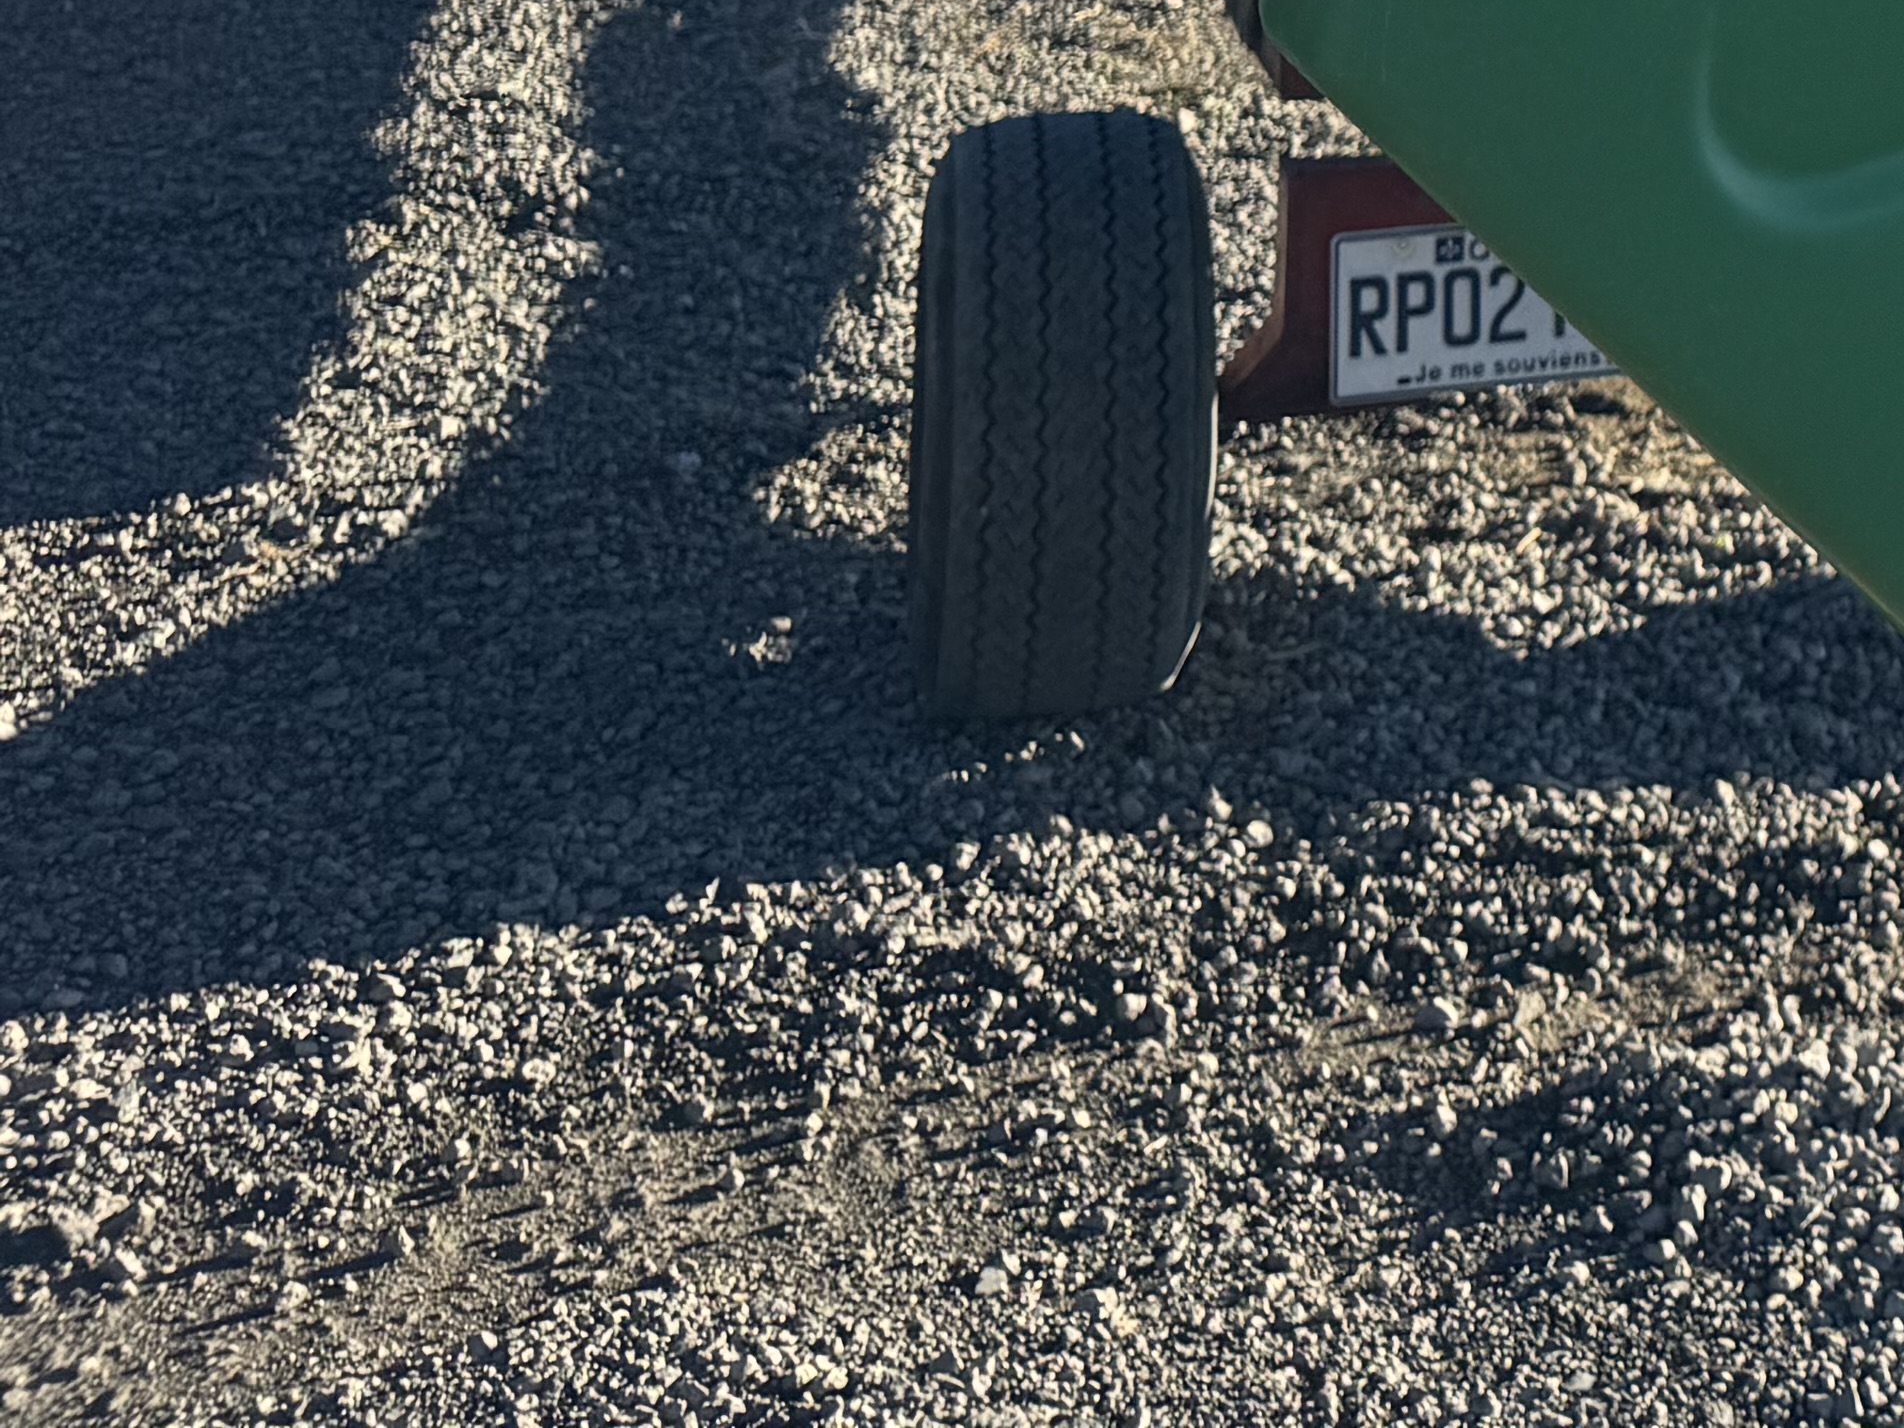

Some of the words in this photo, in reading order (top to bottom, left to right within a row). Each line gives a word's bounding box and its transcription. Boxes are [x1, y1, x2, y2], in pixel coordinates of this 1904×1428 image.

[1349, 266, 1566, 358] RP02
[1415, 364, 1442, 382] Je
[1450, 361, 1485, 378] me
[1494, 349, 1600, 373] souviens
